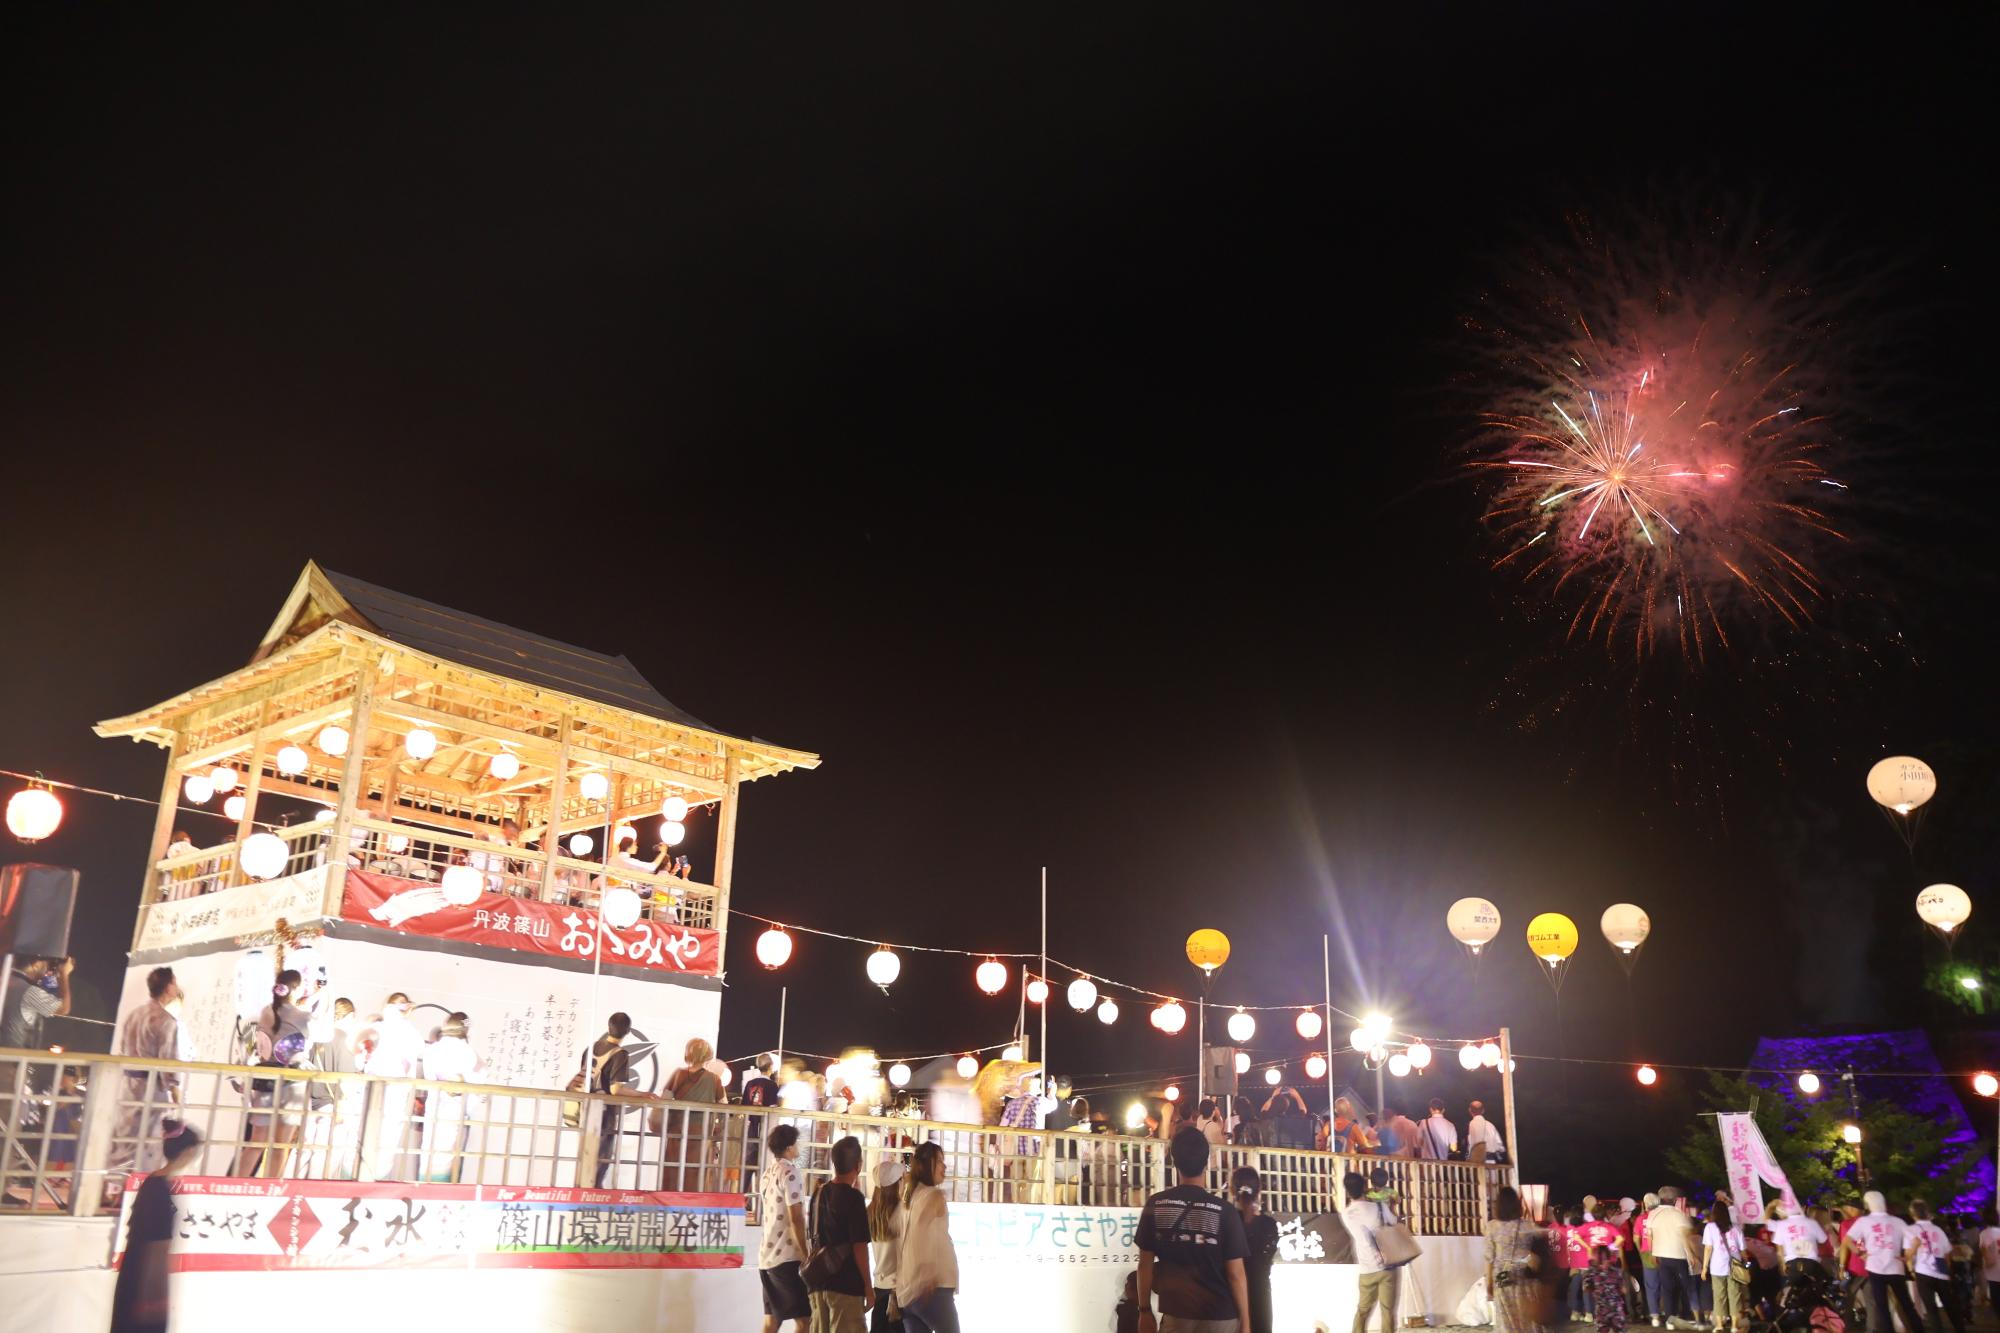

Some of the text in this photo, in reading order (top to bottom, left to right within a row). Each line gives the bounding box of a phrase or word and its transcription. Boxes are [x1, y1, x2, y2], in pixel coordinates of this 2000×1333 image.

[473, 909, 551, 938] 丹波篠山
[566, 998, 580, 1058] デカンショ
[496, 1188, 645, 1204] For Beautiful Future Japan
[179, 1207, 259, 1240] ささやま
